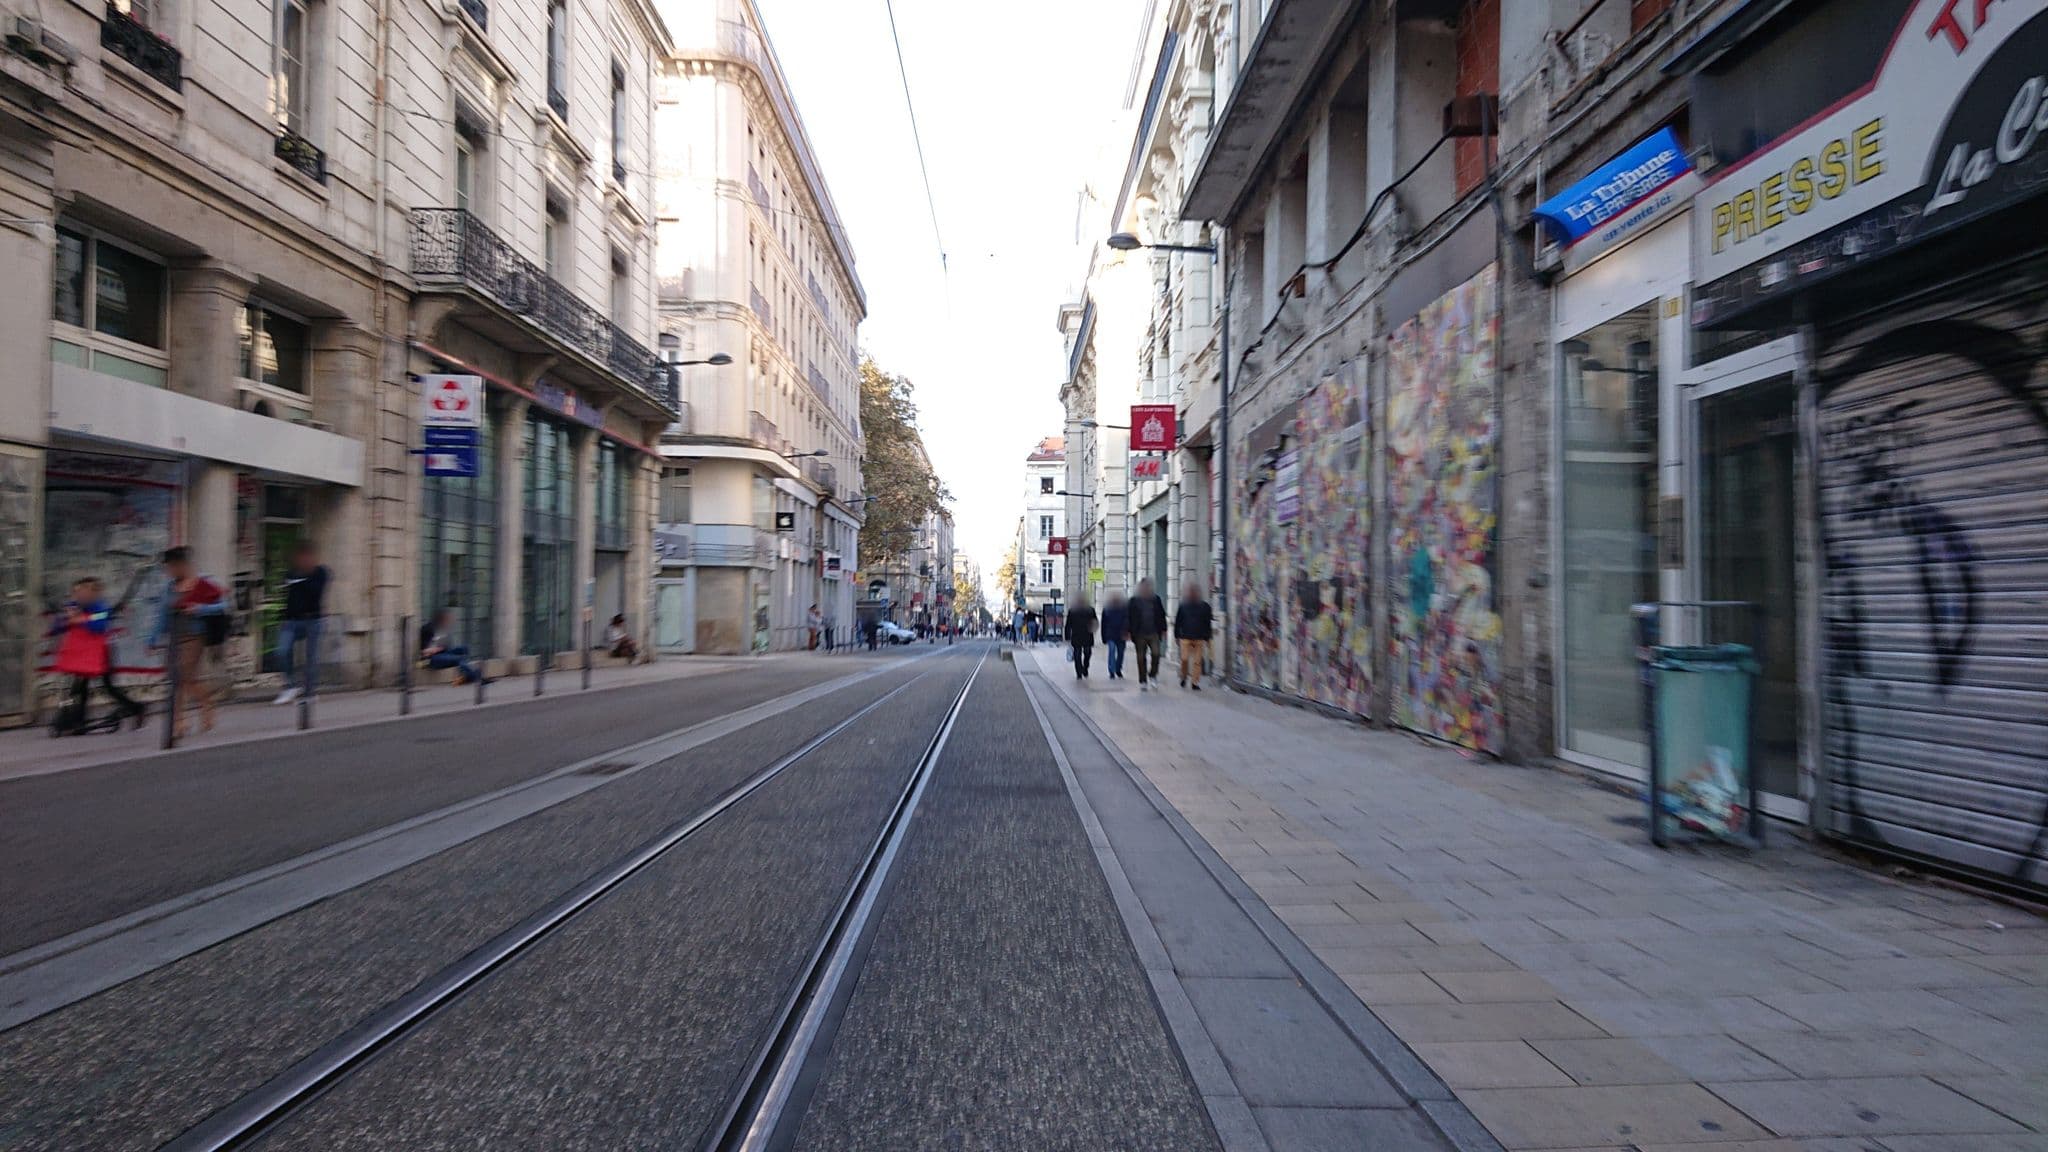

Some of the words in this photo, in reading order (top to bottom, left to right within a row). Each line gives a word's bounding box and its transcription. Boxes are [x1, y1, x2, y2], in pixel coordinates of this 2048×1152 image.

[1564, 197, 1598, 222] La
[1591, 148, 1679, 201] Tribune
[1712, 114, 1886, 255] PRESSE
[1923, 142, 1999, 216] La
[1619, 205, 1655, 231] vente
